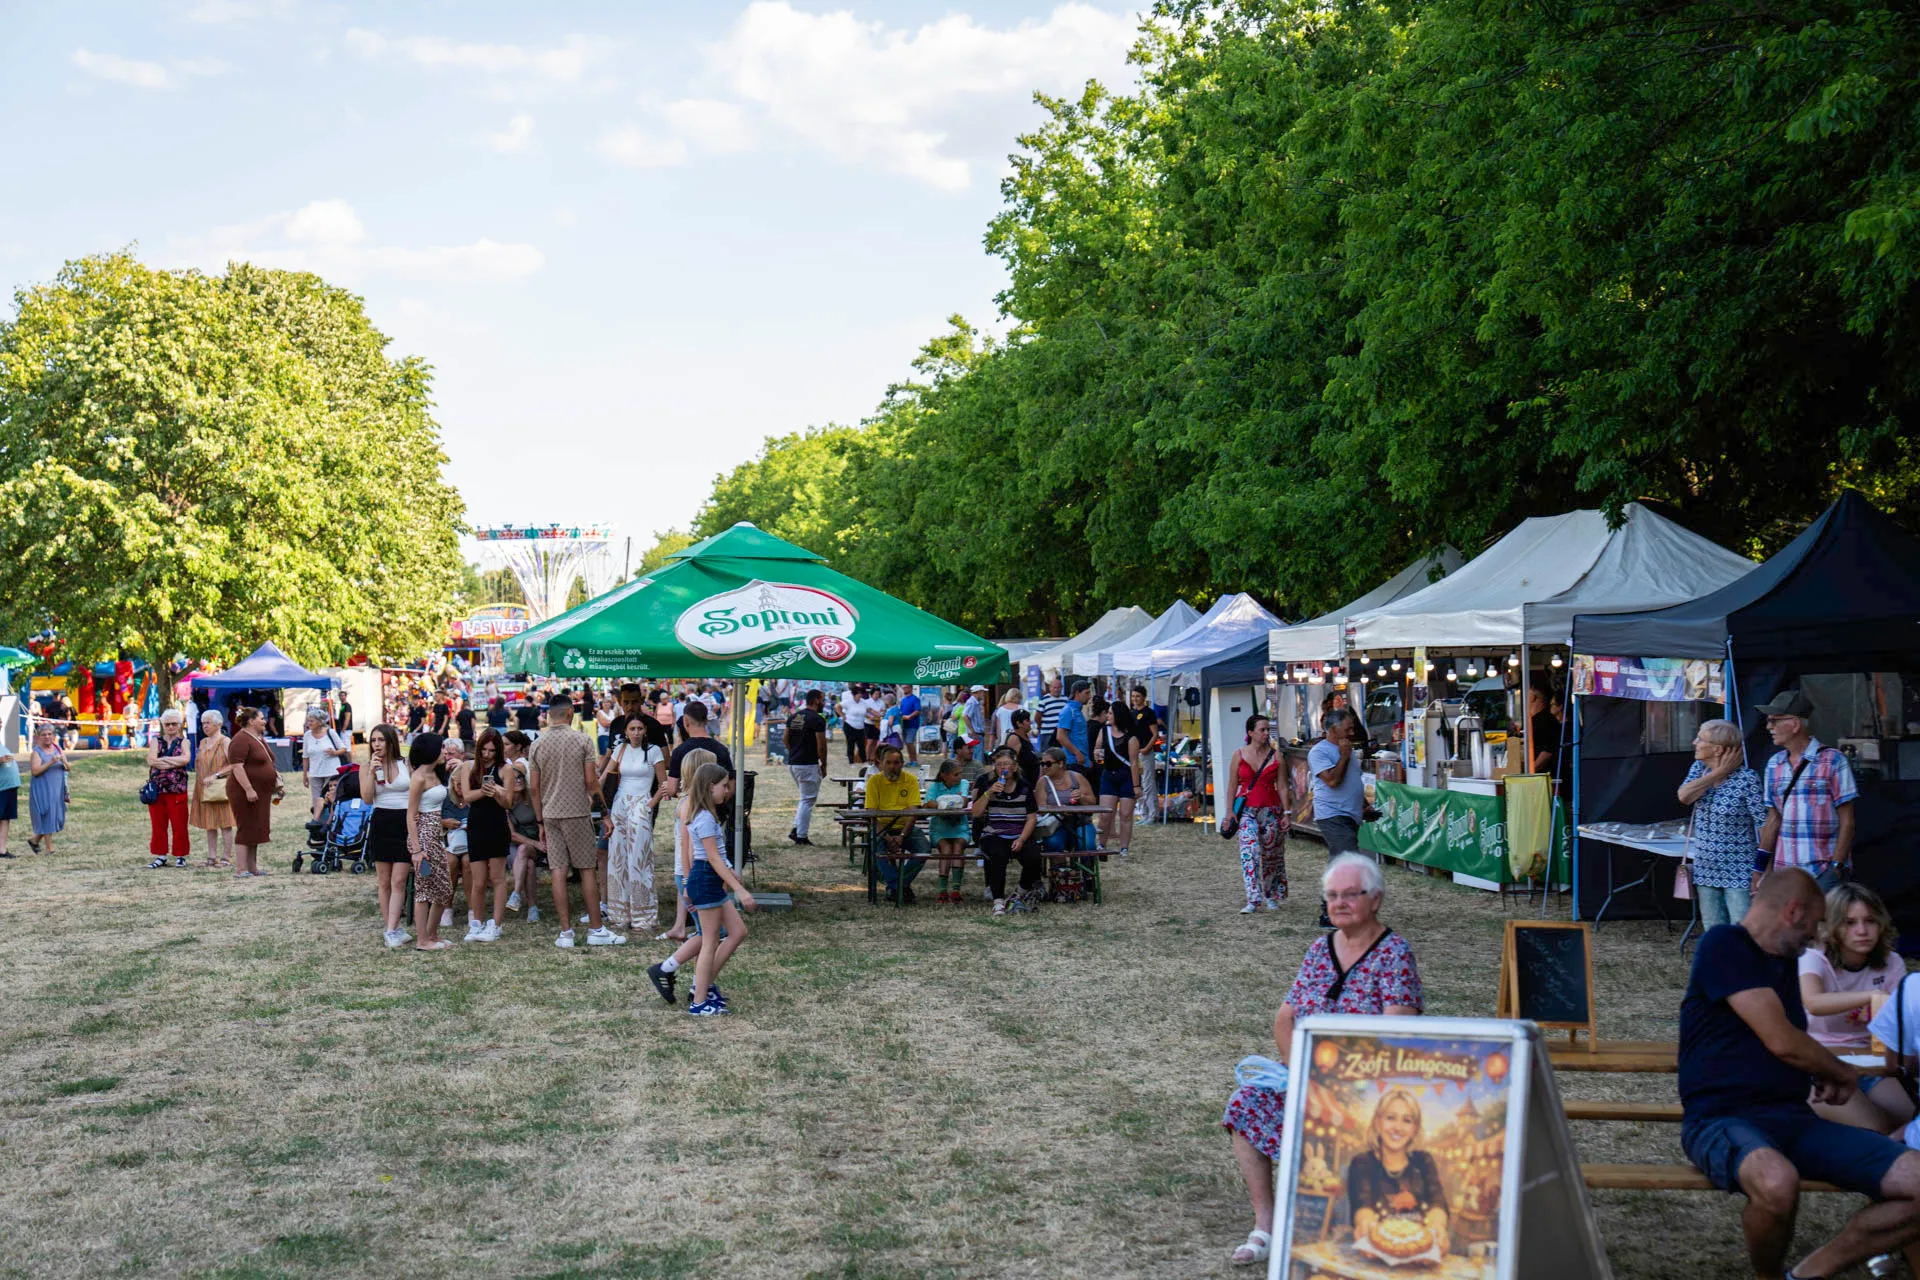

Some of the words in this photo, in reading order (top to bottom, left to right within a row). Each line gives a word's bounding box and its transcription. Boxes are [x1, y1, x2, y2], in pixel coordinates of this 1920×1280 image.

[492, 619, 529, 636] VEGA
[698, 607, 843, 638] Soproni
[914, 656, 961, 679] Soproni
